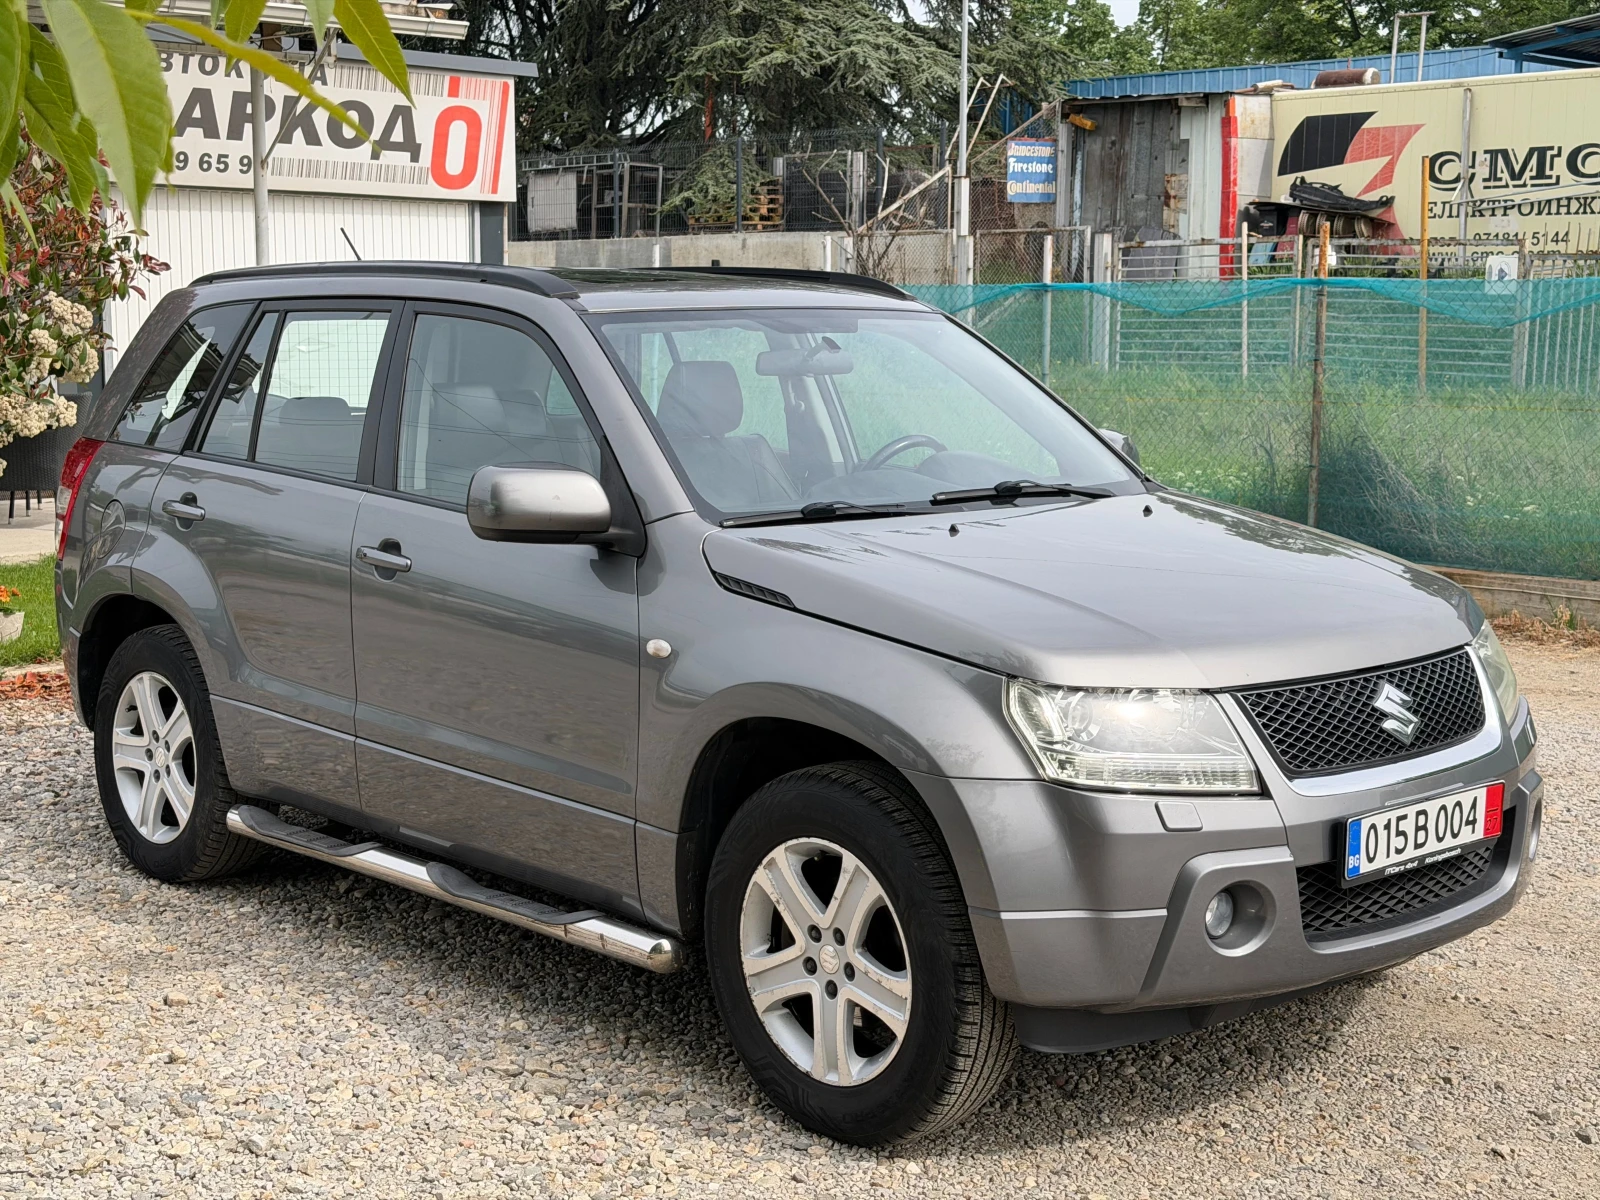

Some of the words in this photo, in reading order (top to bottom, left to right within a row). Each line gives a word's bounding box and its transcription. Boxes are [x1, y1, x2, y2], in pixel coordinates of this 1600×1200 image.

[170, 87, 422, 164] АРКОД
[1009, 157, 1053, 173] Firestone
[1007, 180, 1055, 195] Continental
[1348, 855, 1360, 869] BG
